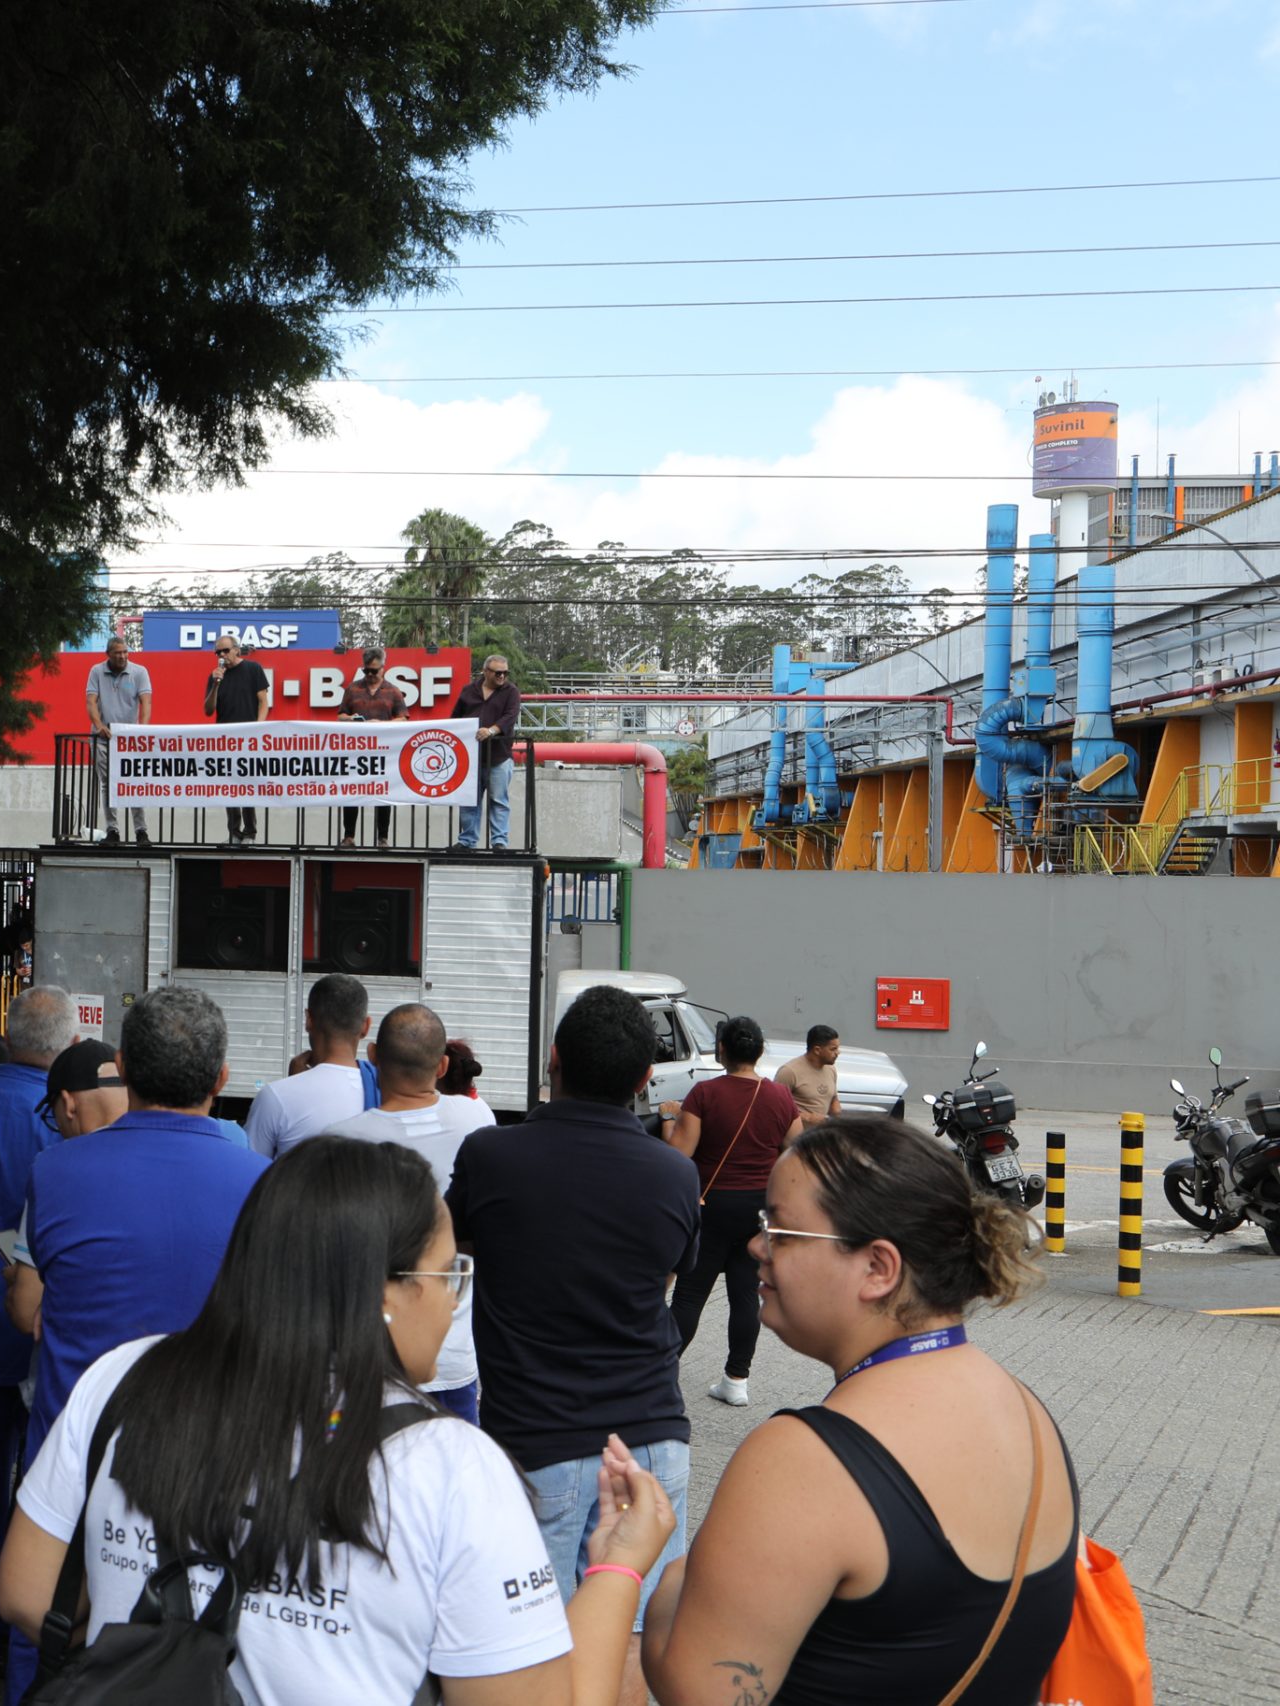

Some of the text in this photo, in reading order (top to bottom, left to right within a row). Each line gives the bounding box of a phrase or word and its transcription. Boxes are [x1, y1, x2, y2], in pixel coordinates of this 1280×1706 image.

[1040, 419, 1085, 435] Suvinil
[1048, 439, 1079, 448] COMPLETO
[221, 624, 298, 649] BASF
[310, 666, 453, 708] BSF
[116, 733, 390, 753] BASF vai vender a Suvinil/Glasu...
[120, 755, 386, 777] DEFENDA-SE! SINDICALIZE-SE!
[116, 780, 390, 798] Direitos e empregos não estão à venda!
[912, 990, 922, 1001] H
[78, 1005, 103, 1025] REVE
[910, 1338, 938, 1353] BASF
[104, 1519, 157, 1554] Be Yo
[528, 1563, 554, 1591] BAS
[101, 1548, 138, 1574] Grupo
[266, 1601, 352, 1636] LGBTQ+
